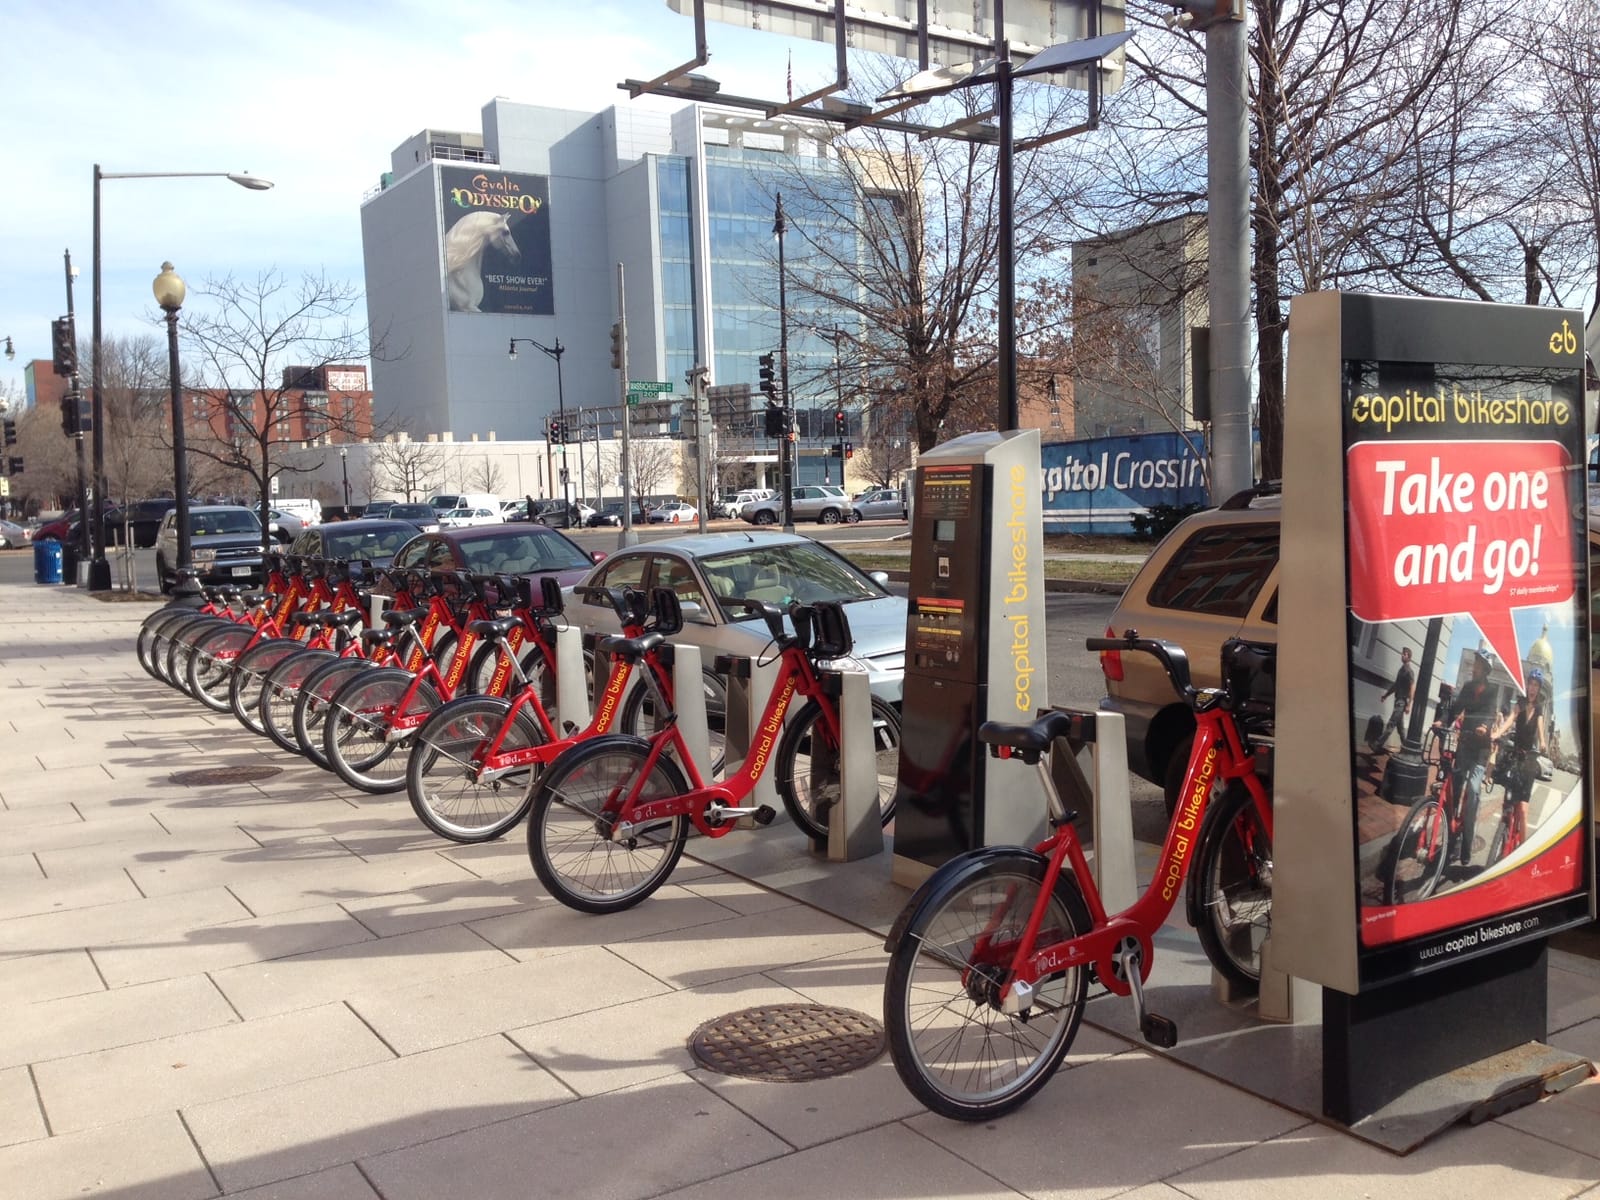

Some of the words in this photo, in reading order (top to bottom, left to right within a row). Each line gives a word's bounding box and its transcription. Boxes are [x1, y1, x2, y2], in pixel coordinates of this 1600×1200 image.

[451, 188, 542, 214] ODYSSEO
[472, 174, 520, 194] Cavalia
[506, 275, 526, 285] SHOW
[1352, 389, 1446, 432] capital
[1453, 383, 1570, 425] bikeshare
[1375, 456, 1475, 516] Take
[1483, 470, 1549, 511] one
[1003, 463, 1028, 605] bikeshare
[1394, 525, 1476, 587] and
[1483, 524, 1542, 594] go!
[447, 659, 463, 687] capital
[489, 668, 506, 697] apital
[1008, 614, 1035, 712] capital
[597, 695, 616, 733] capital
[750, 735, 772, 779] capital
[764, 677, 795, 732] bikeshare
[1163, 834, 1189, 901] capital
[1178, 748, 1217, 831] bikeshare
